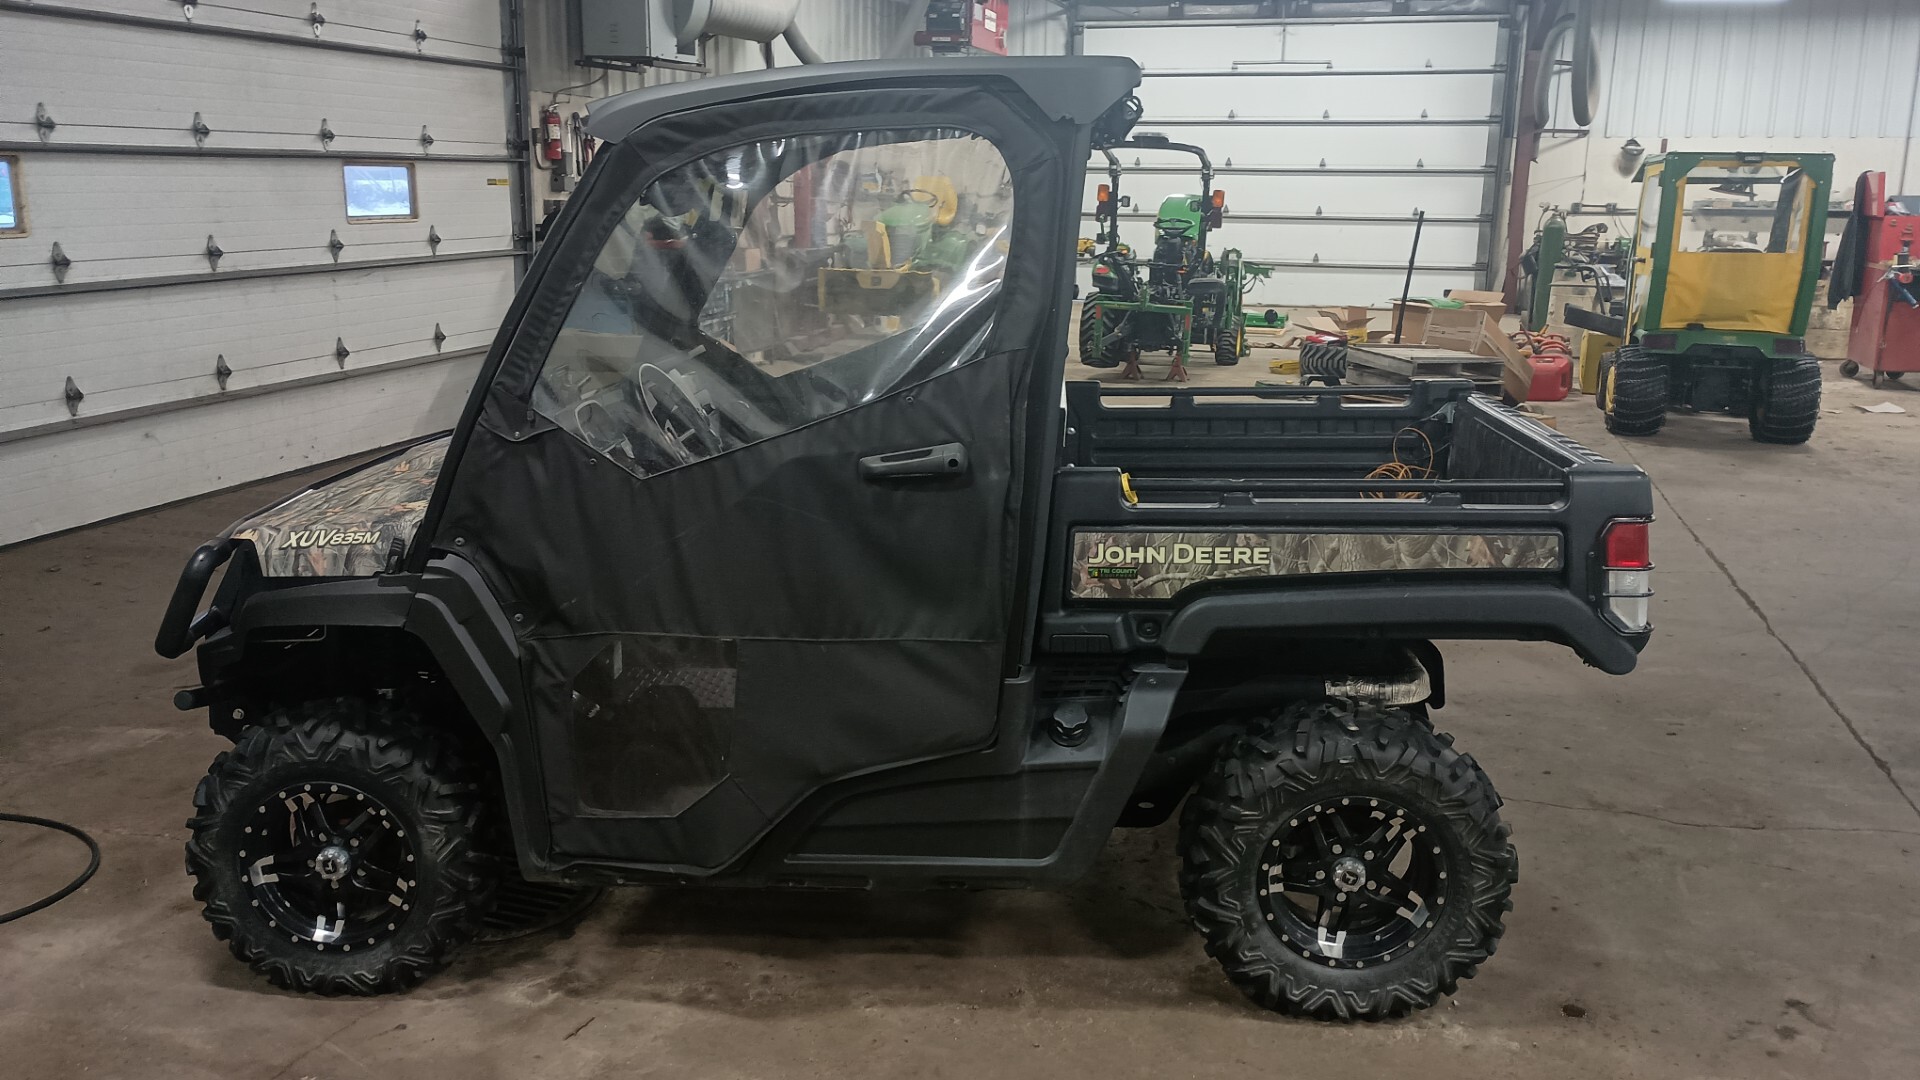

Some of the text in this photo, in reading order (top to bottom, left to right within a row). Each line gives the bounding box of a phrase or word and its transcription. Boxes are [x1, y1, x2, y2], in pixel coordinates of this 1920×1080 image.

[280, 529, 381, 549] XUV835M
[1088, 543, 1271, 565] JOHN DEERE
